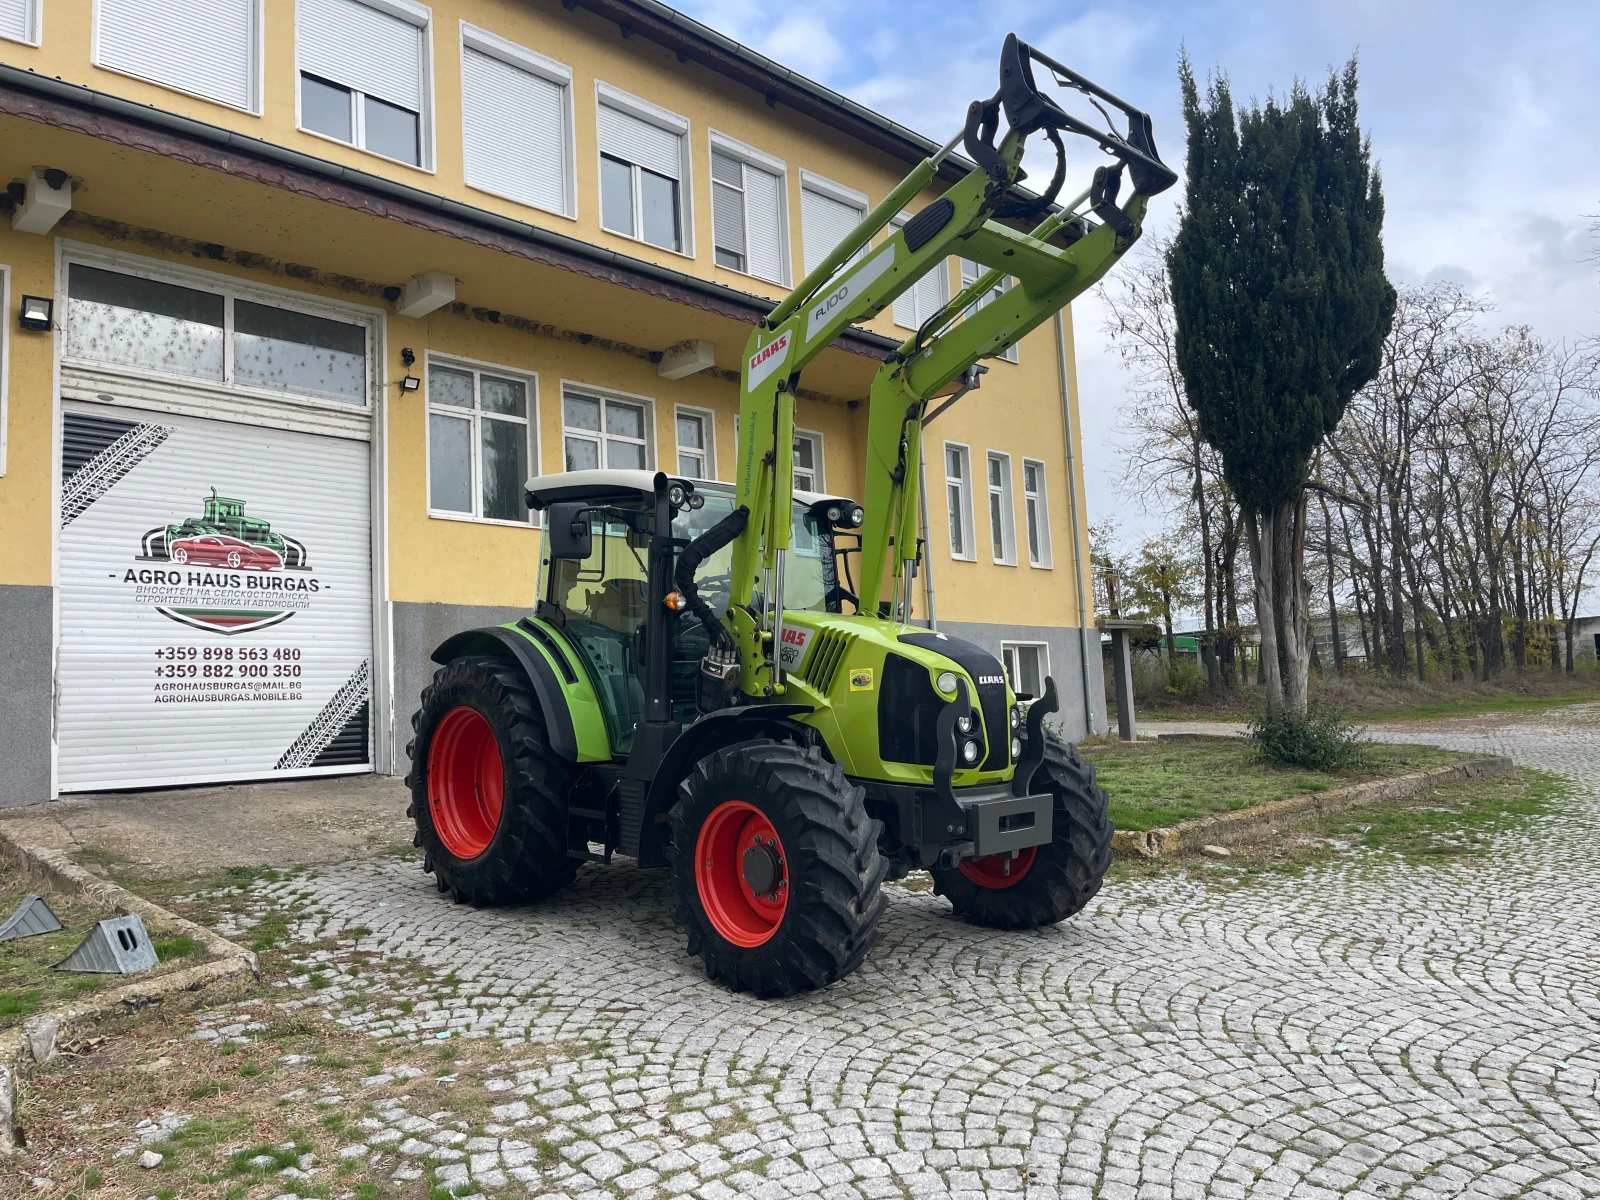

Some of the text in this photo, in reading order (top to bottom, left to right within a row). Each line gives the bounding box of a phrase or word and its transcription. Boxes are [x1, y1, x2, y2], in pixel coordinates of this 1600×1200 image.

[751, 335, 787, 369] CLAAS
[123, 569, 182, 586] AGRO
[187, 572, 241, 589] HAUS
[246, 575, 320, 592] BURGAS
[136, 585, 310, 601] ВНОСИТЕЛ НА СЕЛСКОСТОПАНСКА
[136, 594, 198, 605] СТРОИТЕЛНА
[201, 597, 241, 606] ТЕХНИКА
[252, 600, 310, 609] АВТОМОБИЛИ
[154, 646, 301, 661] +359 898 563 480
[154, 664, 302, 678] +359 882 900 350
[154, 681, 302, 692] AGROHAUSBURGAS@MAIL.BG
[978, 675, 1005, 685] CLAAS
[154, 692, 303, 703] AGROHAUSBURGAS.MOBILE.BG
